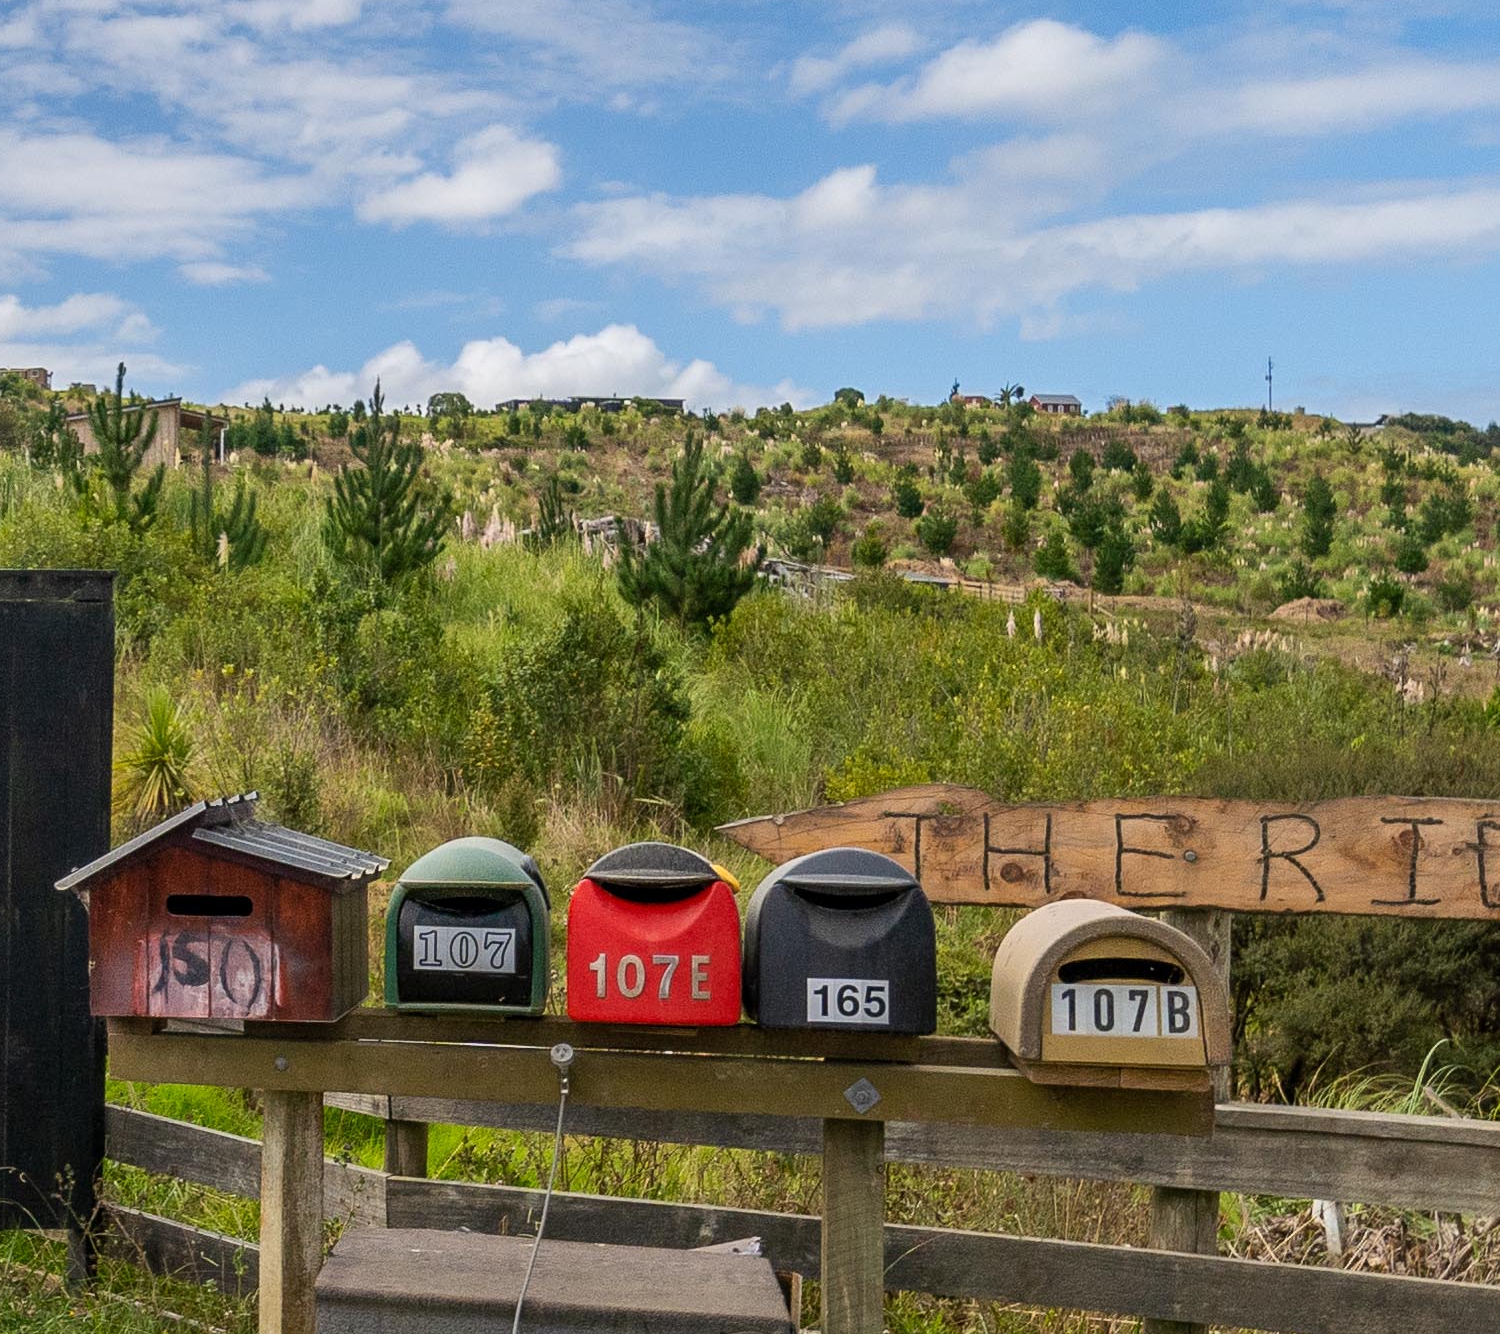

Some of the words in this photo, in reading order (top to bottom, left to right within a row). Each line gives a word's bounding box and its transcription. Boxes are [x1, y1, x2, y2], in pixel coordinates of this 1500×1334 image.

[882, 812, 1187, 897] THE
[418, 929, 513, 969] 107
[588, 952, 711, 1000] 107E
[813, 984, 886, 1018] 165
[1061, 988, 1191, 1034] 107B
